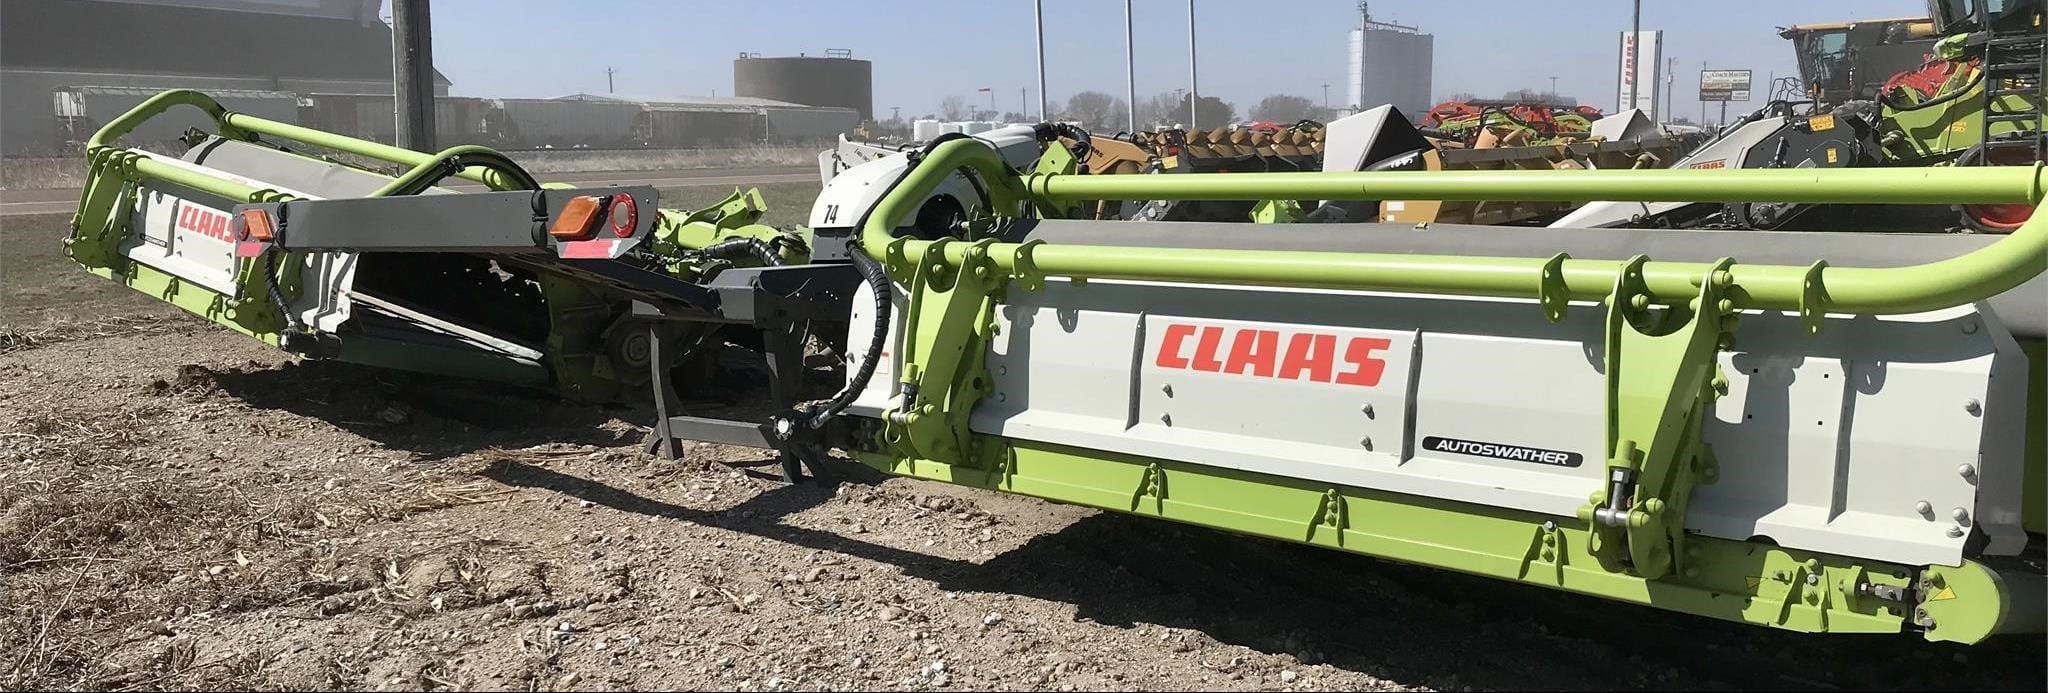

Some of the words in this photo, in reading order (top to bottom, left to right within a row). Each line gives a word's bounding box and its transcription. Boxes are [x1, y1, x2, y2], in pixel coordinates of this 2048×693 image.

[179, 205, 235, 243] CLAAS
[823, 204, 839, 224] 74
[1156, 324, 1392, 387] CLAAS
[1436, 439, 1569, 465] AUTOSWATHER
